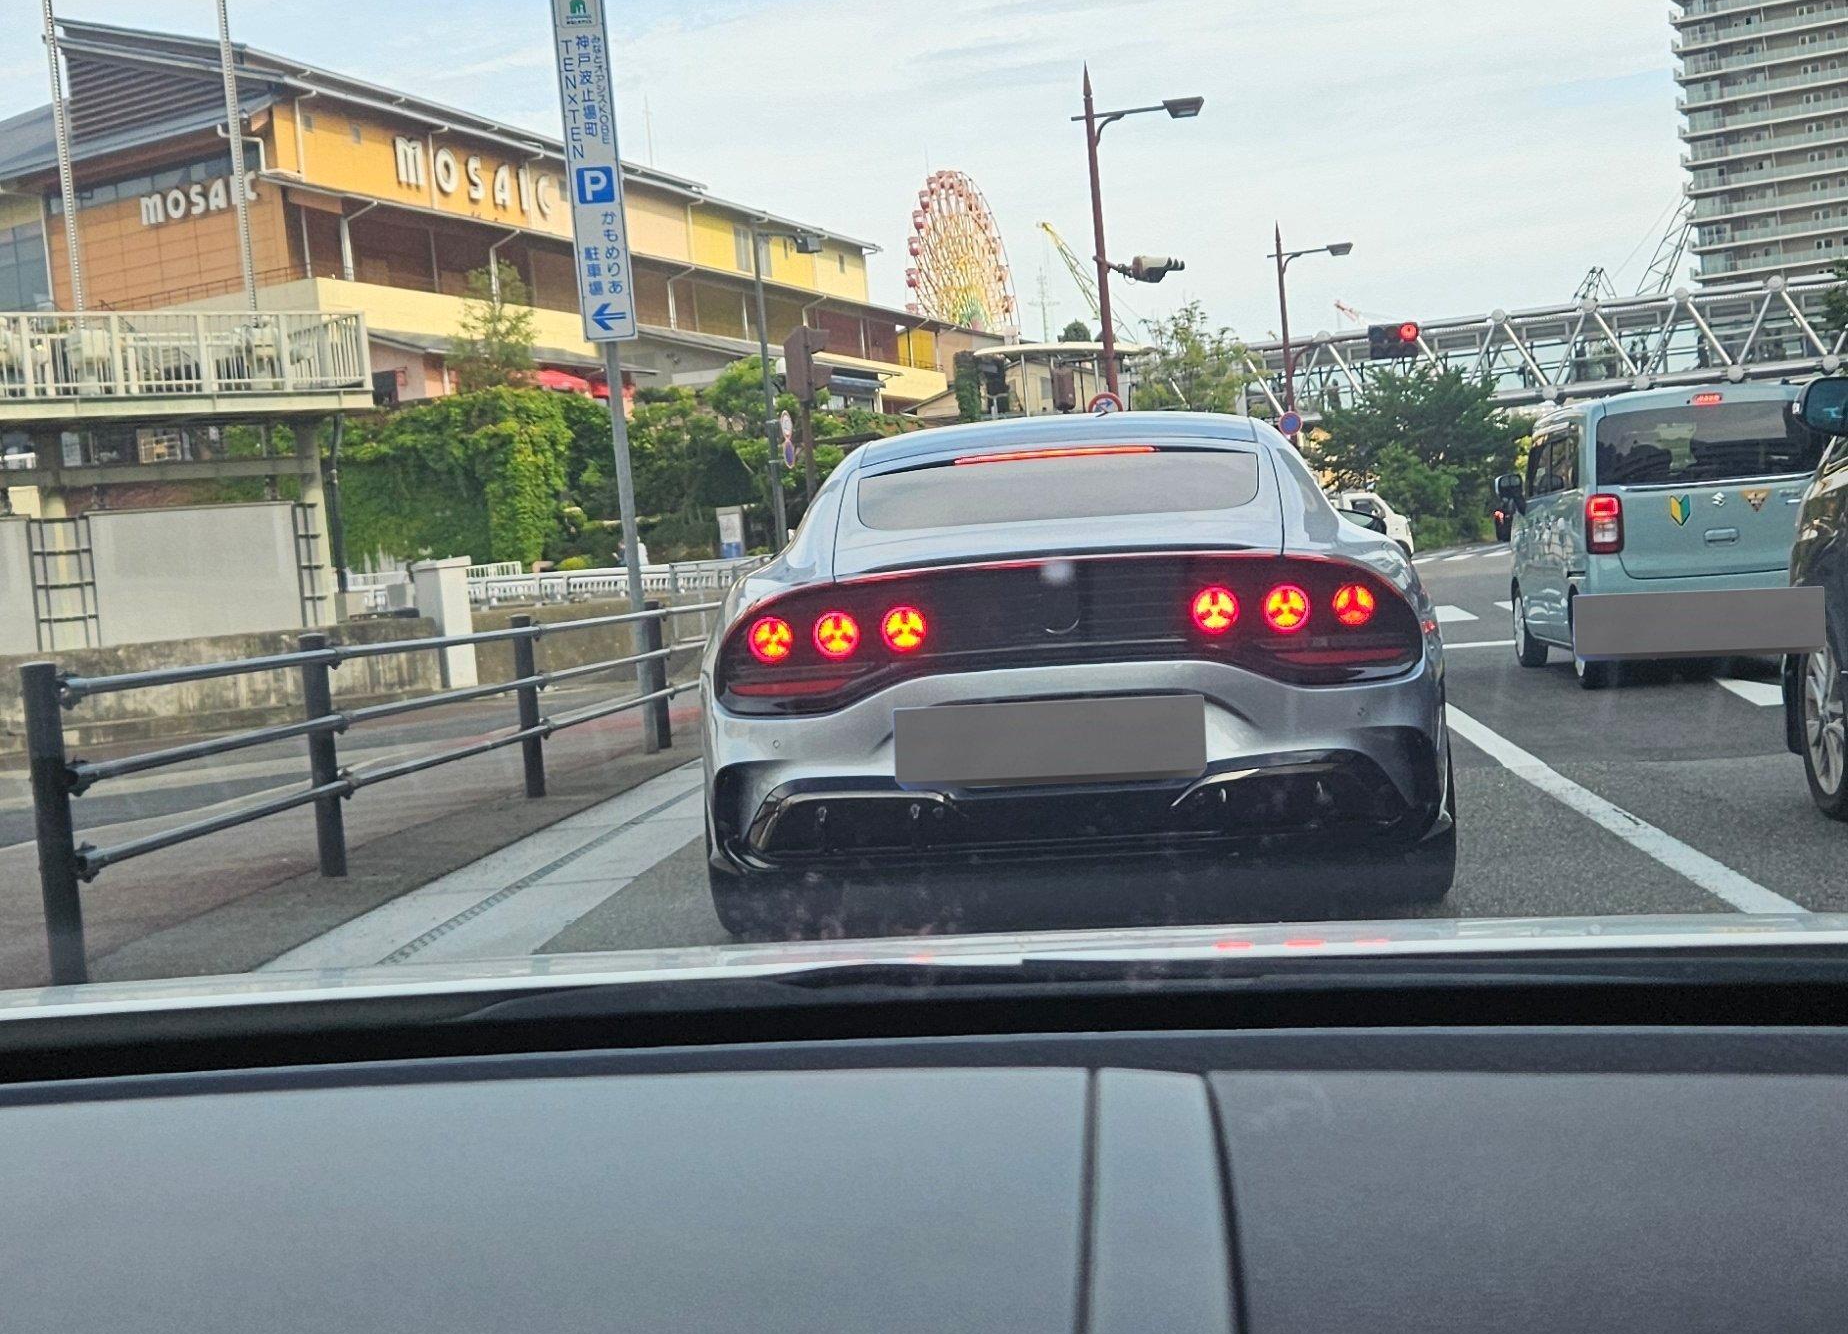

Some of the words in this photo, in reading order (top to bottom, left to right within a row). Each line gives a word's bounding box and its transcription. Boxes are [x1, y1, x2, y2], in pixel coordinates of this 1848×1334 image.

[575, 34, 598, 137] 神戸波止場町
[394, 136, 558, 217] MOSAIC
[583, 170, 608, 201] P
[584, 246, 604, 296] 駐車場
[601, 211, 624, 294] かもめりあ
